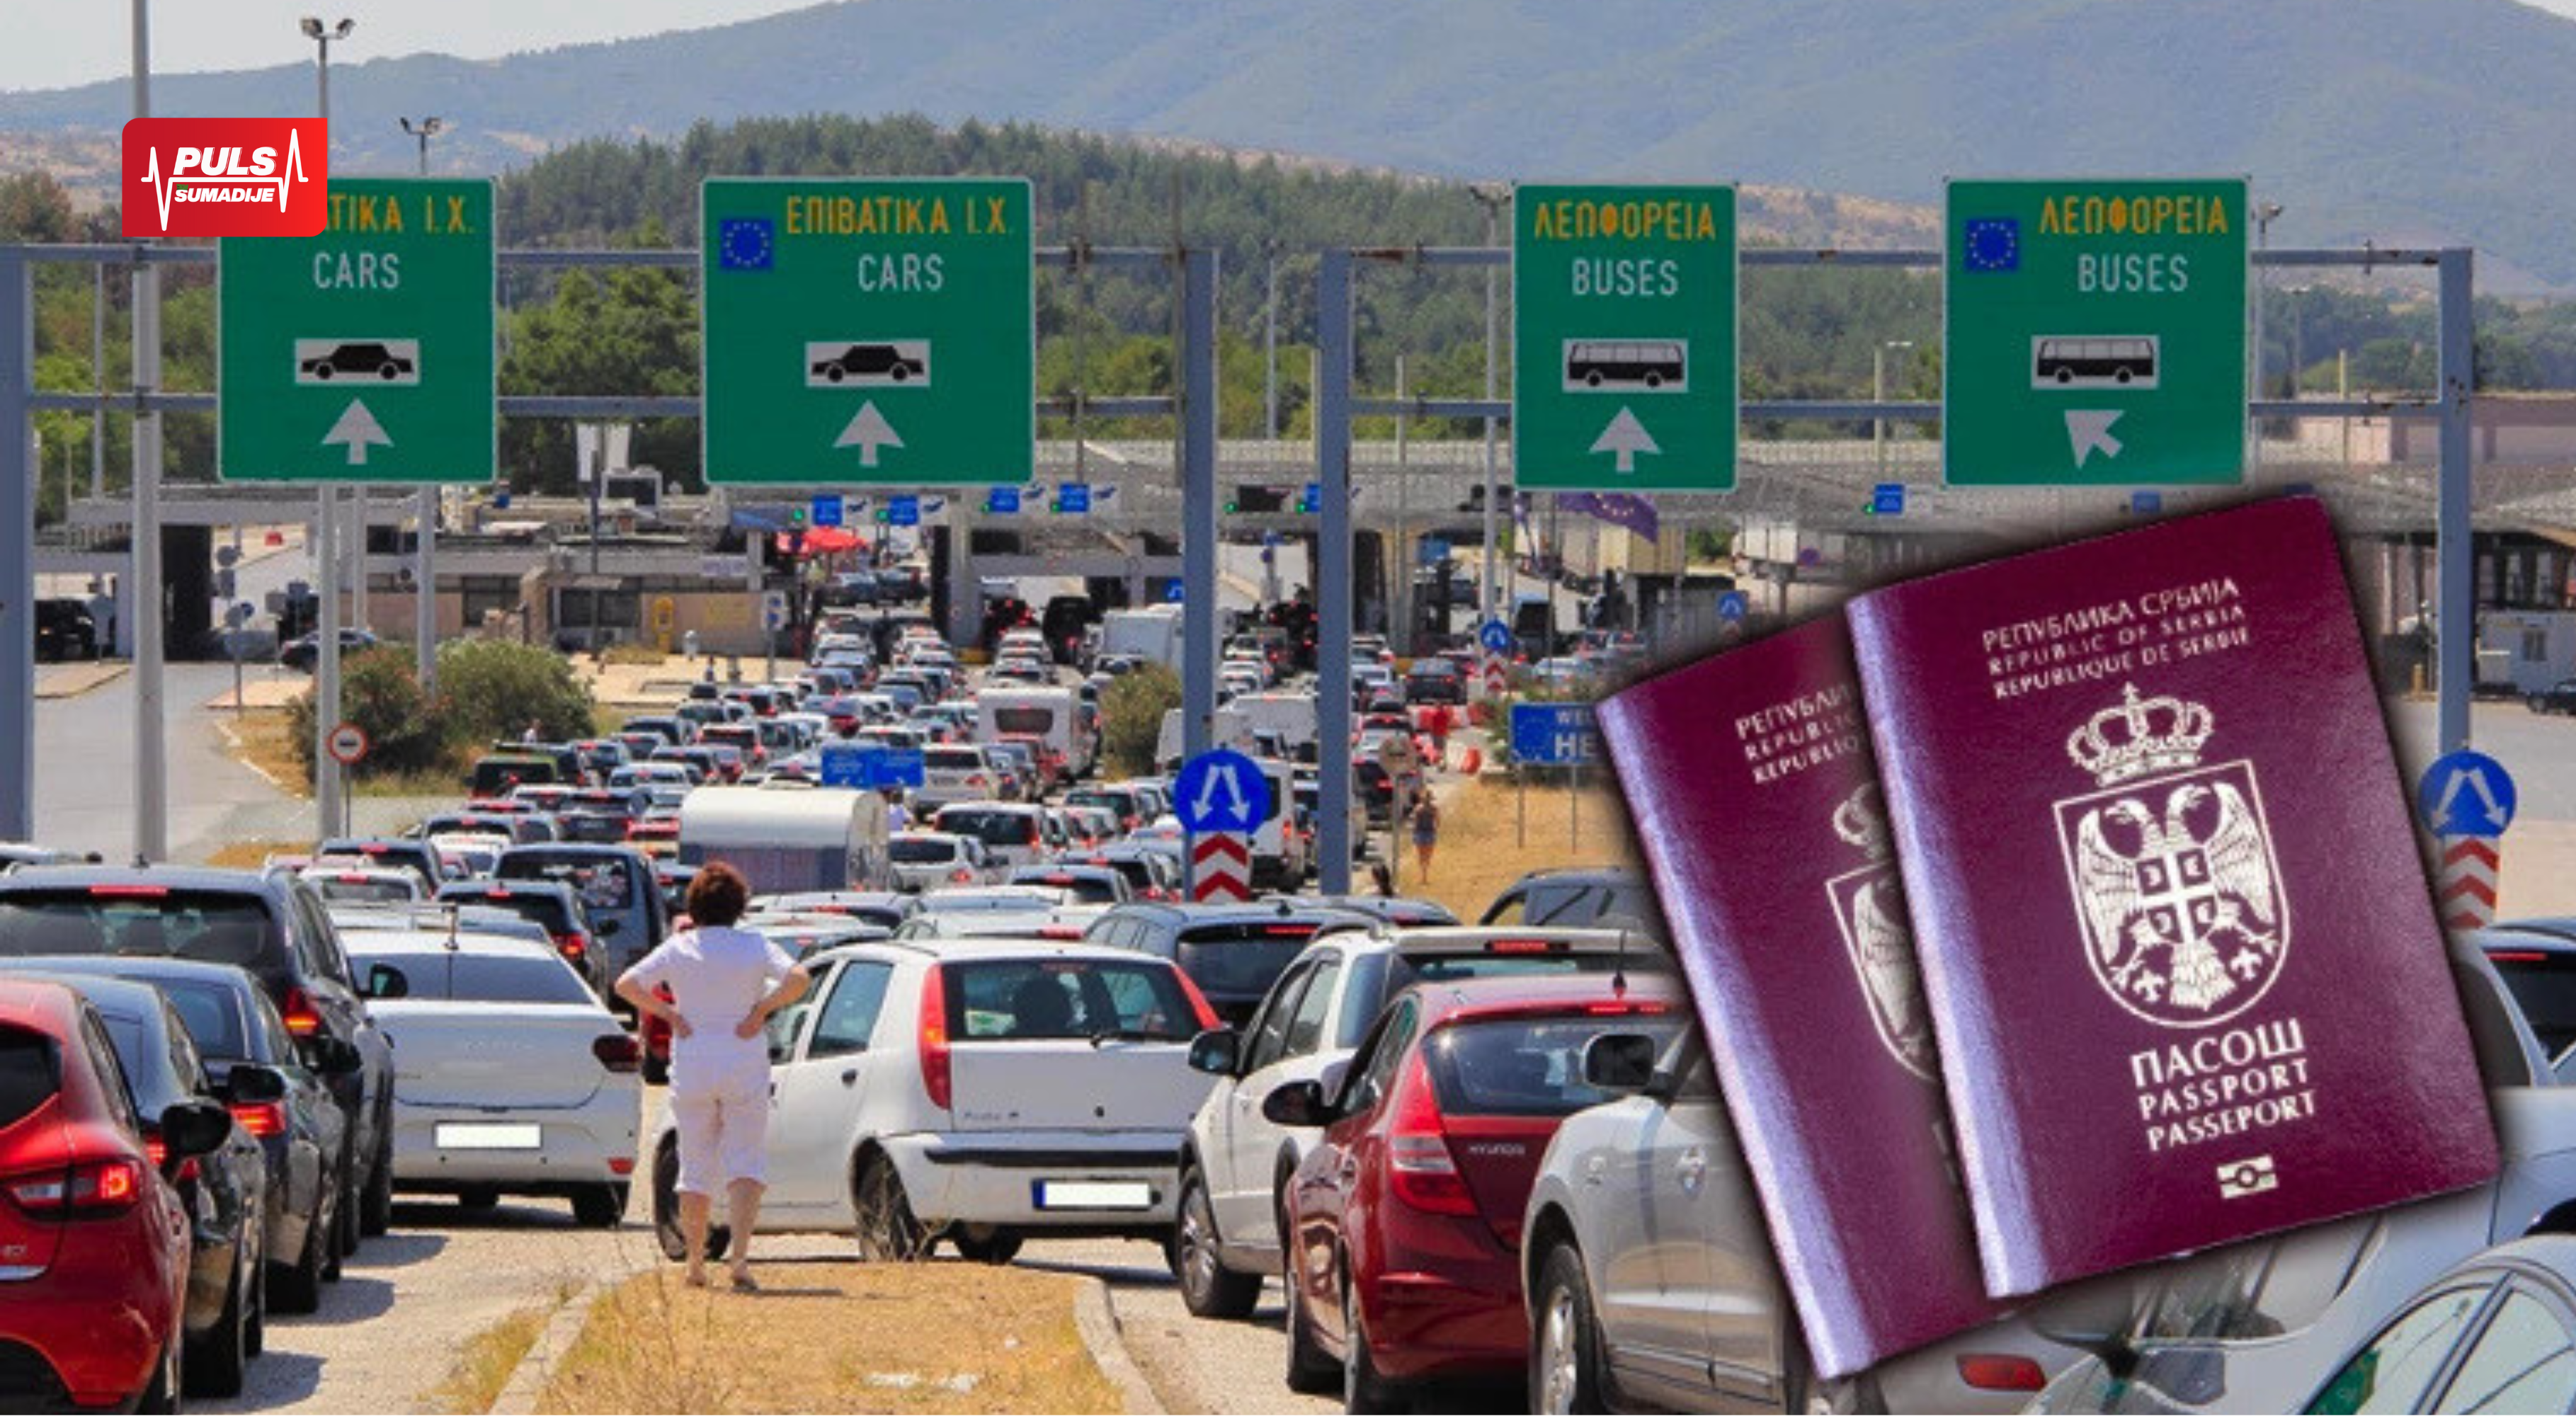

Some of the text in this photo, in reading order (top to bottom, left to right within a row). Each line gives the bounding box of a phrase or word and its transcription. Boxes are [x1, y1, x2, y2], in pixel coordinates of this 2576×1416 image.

[327, 194, 404, 232] ΤΙΚΑ
[314, 252, 400, 289] CARS
[858, 253, 945, 292] CARS
[1572, 258, 1679, 296] BUSES
[2078, 253, 2189, 292] BUSES
[1983, 600, 2136, 653] РЕПУБЛИКА
[1988, 603, 2245, 676] REPUBLIC OF SERBIA
[2142, 642, 2171, 666] DE
[2131, 1017, 2305, 1087] ПАСОШ
[2138, 1058, 2308, 1121] PASSPORT
[2146, 1089, 2317, 1152] PASSEPORT
